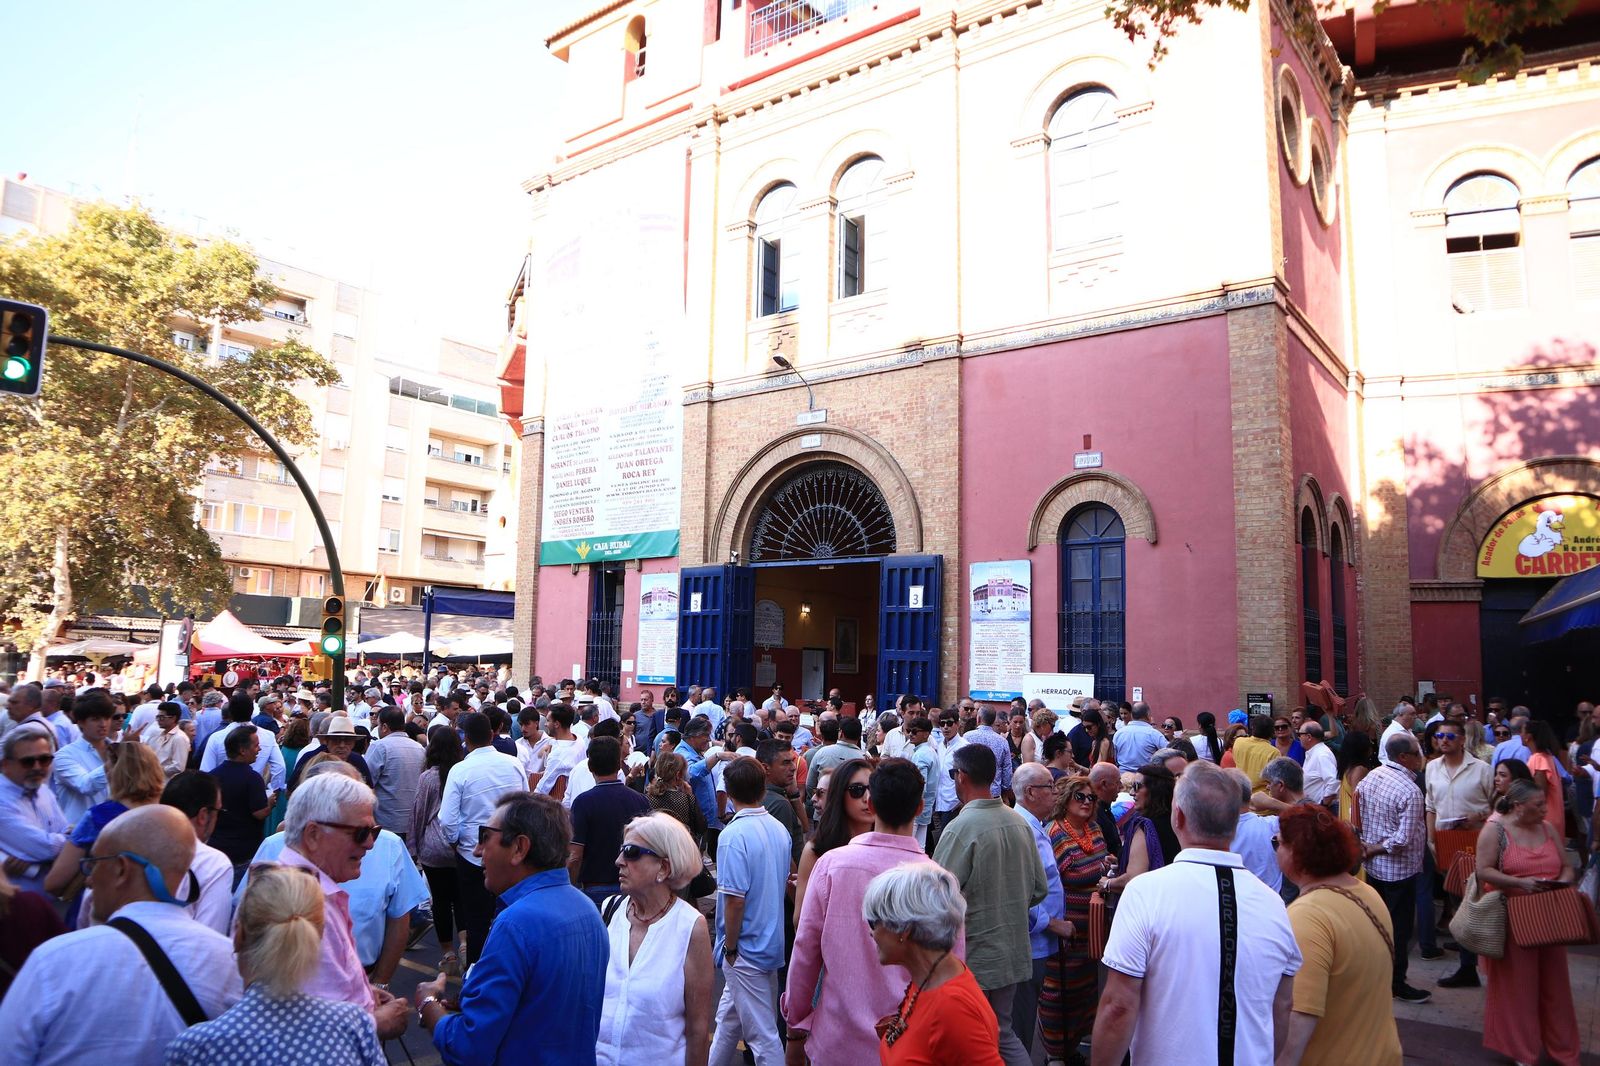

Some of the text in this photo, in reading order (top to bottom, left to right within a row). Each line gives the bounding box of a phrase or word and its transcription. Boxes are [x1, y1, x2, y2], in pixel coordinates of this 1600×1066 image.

[616, 457, 664, 470] JUAN ORTEGA
[622, 468, 657, 480] ROCA REY
[553, 507, 594, 518] DIEGO VENTURA
[573, 515, 595, 524] ROMERO
[1481, 509, 1527, 567] Asador de Pollos
[593, 541, 632, 551] CAJA RURAL
[693, 599, 699, 610] 3
[912, 593, 919, 606] 3
[1041, 688, 1083, 696] HERRADURA
